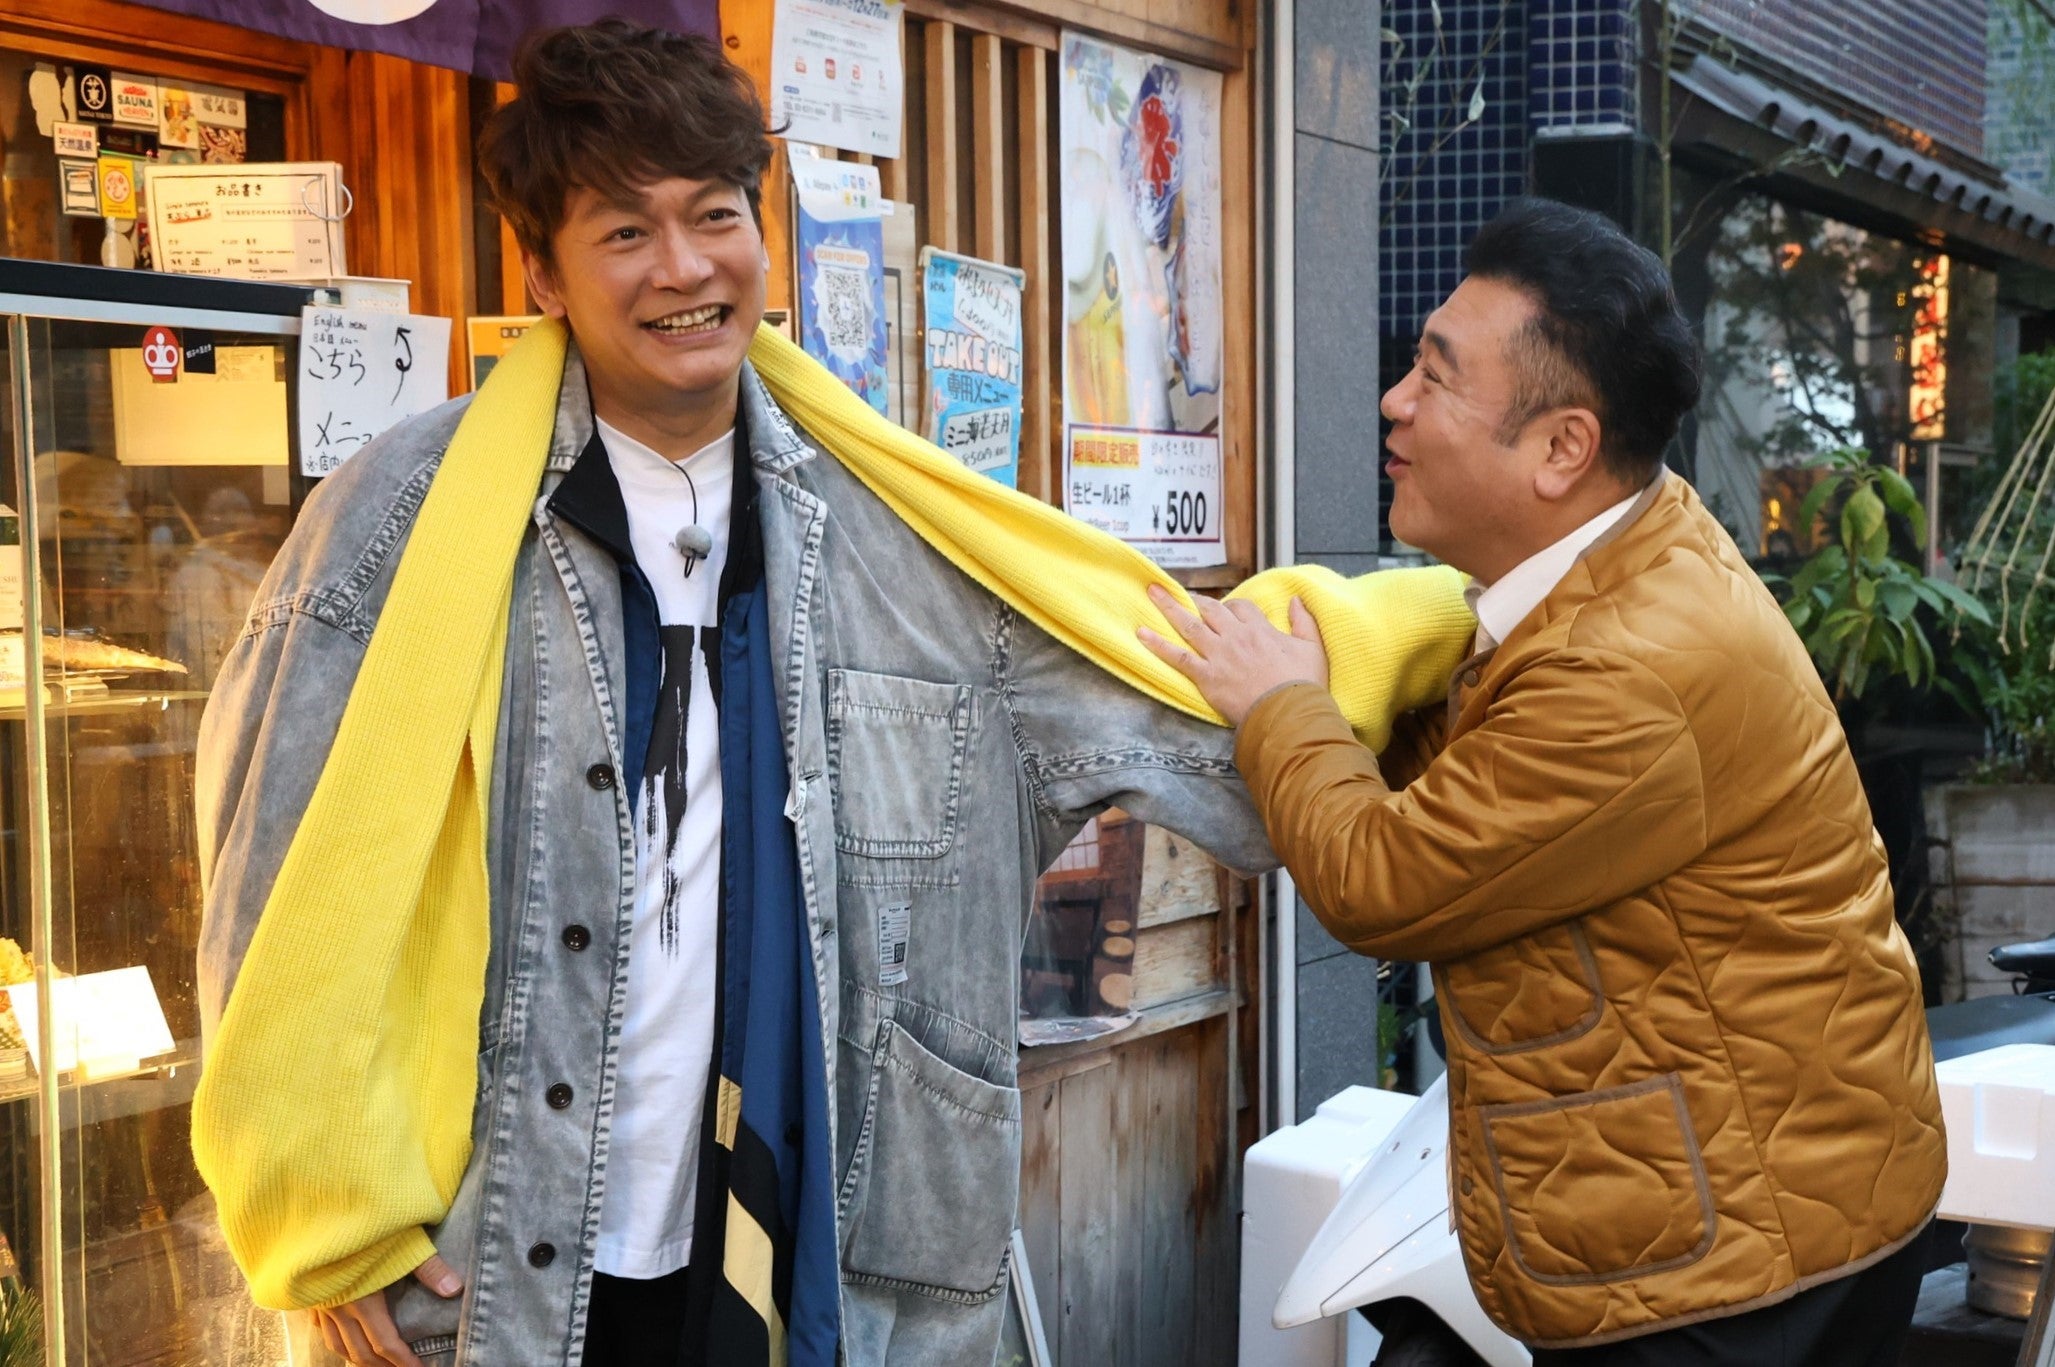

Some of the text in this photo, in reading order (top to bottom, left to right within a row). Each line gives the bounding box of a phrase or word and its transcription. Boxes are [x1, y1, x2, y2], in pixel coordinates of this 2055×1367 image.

[117, 94, 153, 108] SAUNA
[58, 136, 93, 151] 天然温泉
[216, 183, 262, 197] お品書き
[313, 313, 368, 336] English menu
[308, 348, 366, 387] こちら
[928, 328, 1020, 385] TAKE OUT
[947, 372, 1009, 404] 専用メニュー
[1073, 440, 1139, 465] 期間限定販売
[1073, 481, 1131, 506] 生ビール1杯
